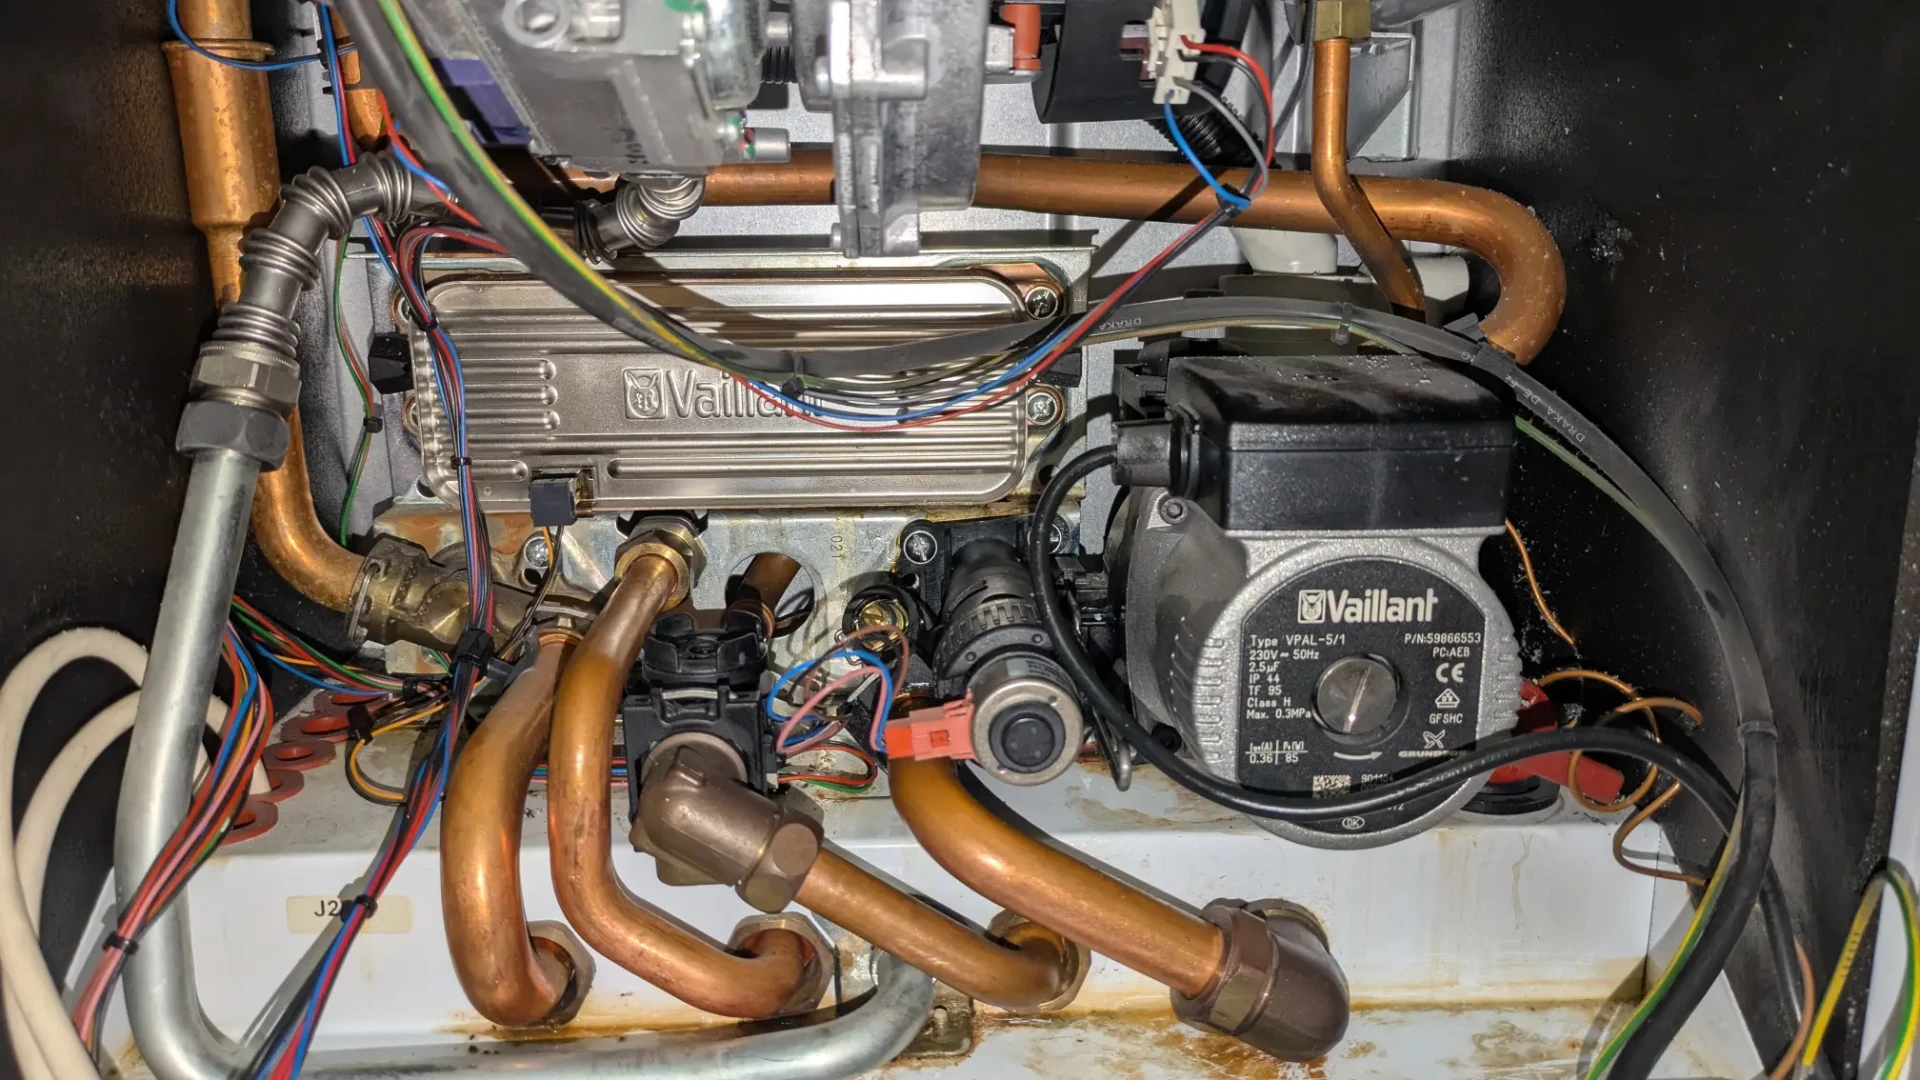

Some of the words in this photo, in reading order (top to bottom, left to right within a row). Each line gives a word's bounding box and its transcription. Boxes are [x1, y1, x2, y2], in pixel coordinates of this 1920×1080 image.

[1100, 317, 1142, 331] DRAKA
[1547, 406, 1586, 443] DRAKA
[1327, 588, 1438, 623] Vaillant
[1250, 634, 1278, 649] Type
[1286, 633, 1346, 646] VPAL-5/1
[1404, 632, 1481, 644] P/N:59866553
[1293, 648, 1319, 660] 50Hz
[1248, 674, 1260, 684] IP
[1266, 673, 1281, 684] 44
[1435, 662, 1465, 683] CE
[1248, 685, 1261, 696] TF
[1268, 685, 1282, 696] 95
[1246, 697, 1277, 708] Class
[1283, 696, 1292, 707] H
[1246, 709, 1270, 720] Max.
[1275, 707, 1312, 719] 0.3MPa
[1249, 753, 1273, 764] 0.36
[1285, 752, 1299, 763] 85
[1346, 818, 1360, 828] DK
